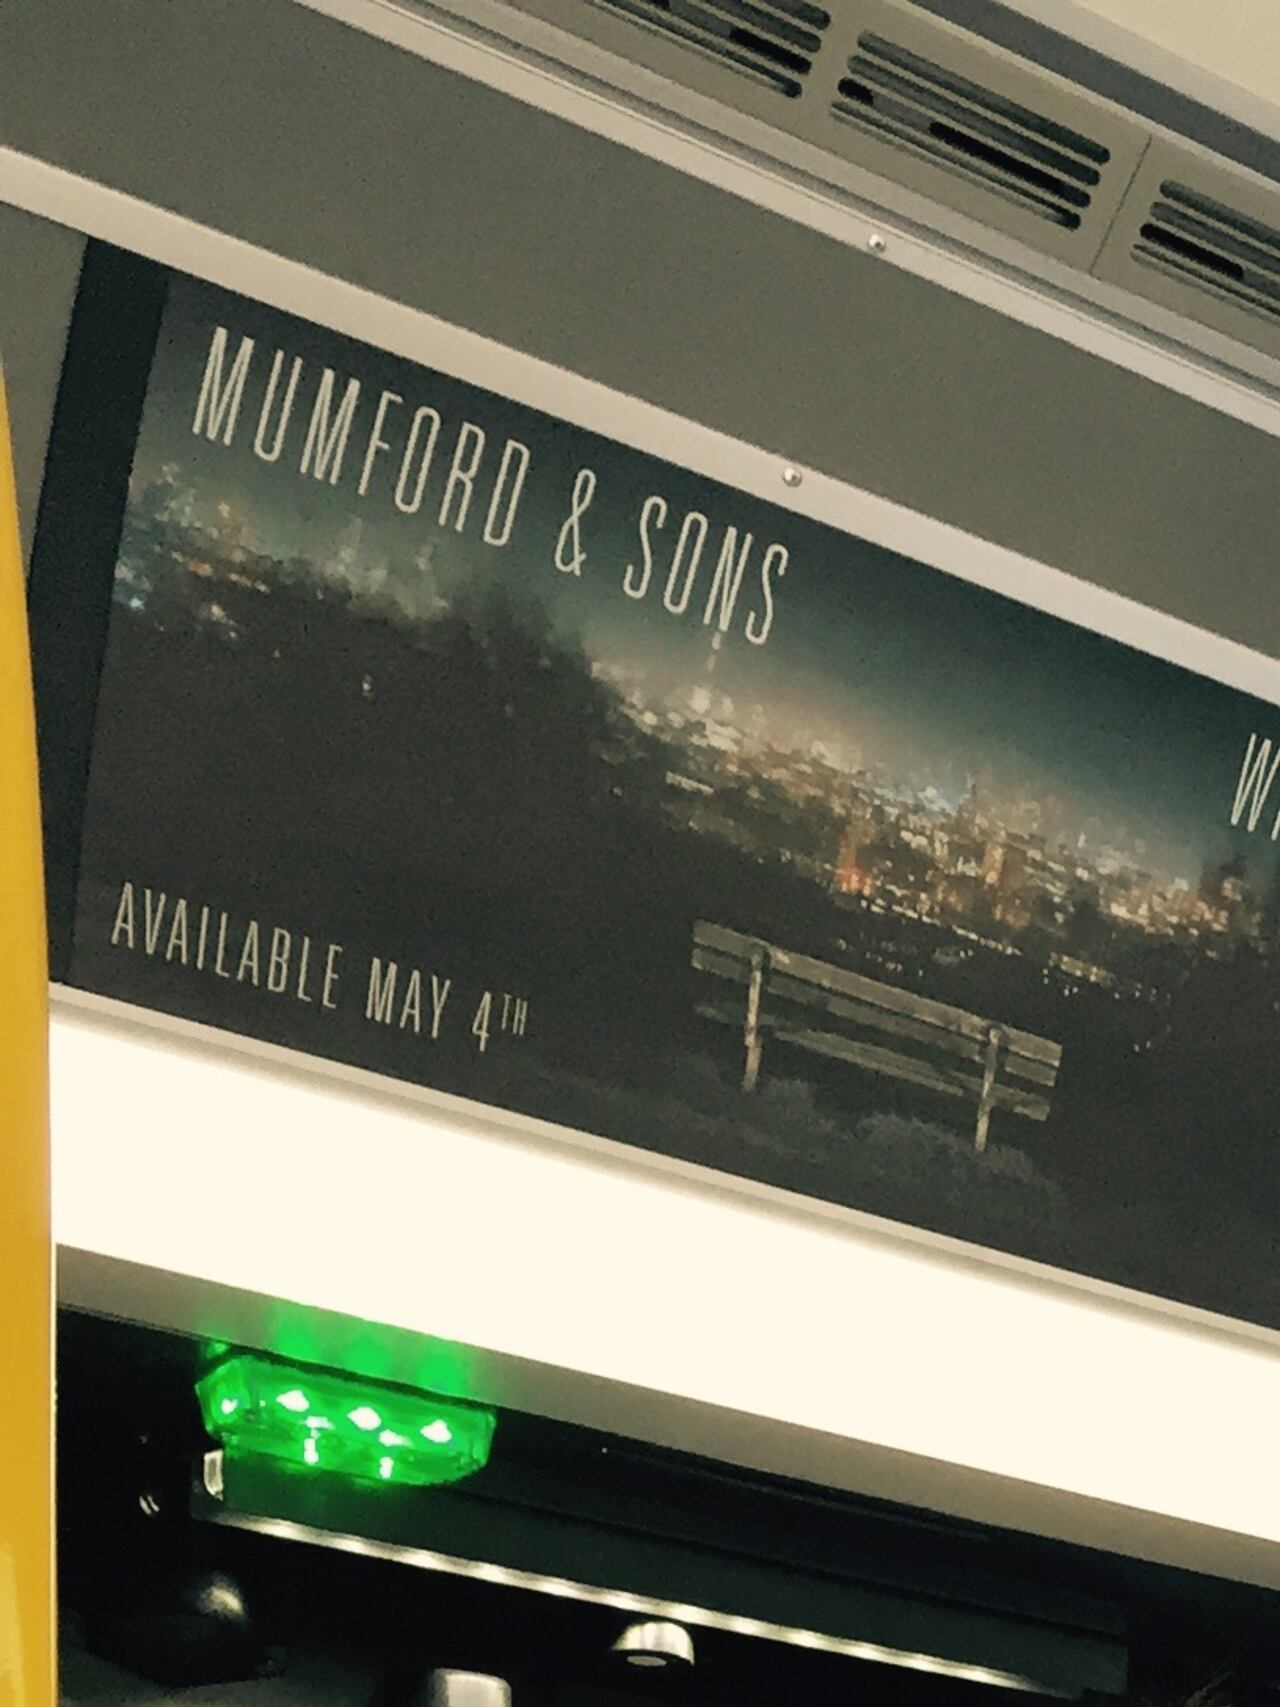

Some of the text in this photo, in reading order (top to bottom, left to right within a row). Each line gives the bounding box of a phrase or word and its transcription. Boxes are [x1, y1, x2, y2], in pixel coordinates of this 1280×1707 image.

[192, 326, 789, 646] MUMFORD & SONS
[110, 881, 344, 1009] AVAILABLE
[365, 957, 451, 1041] MAY
